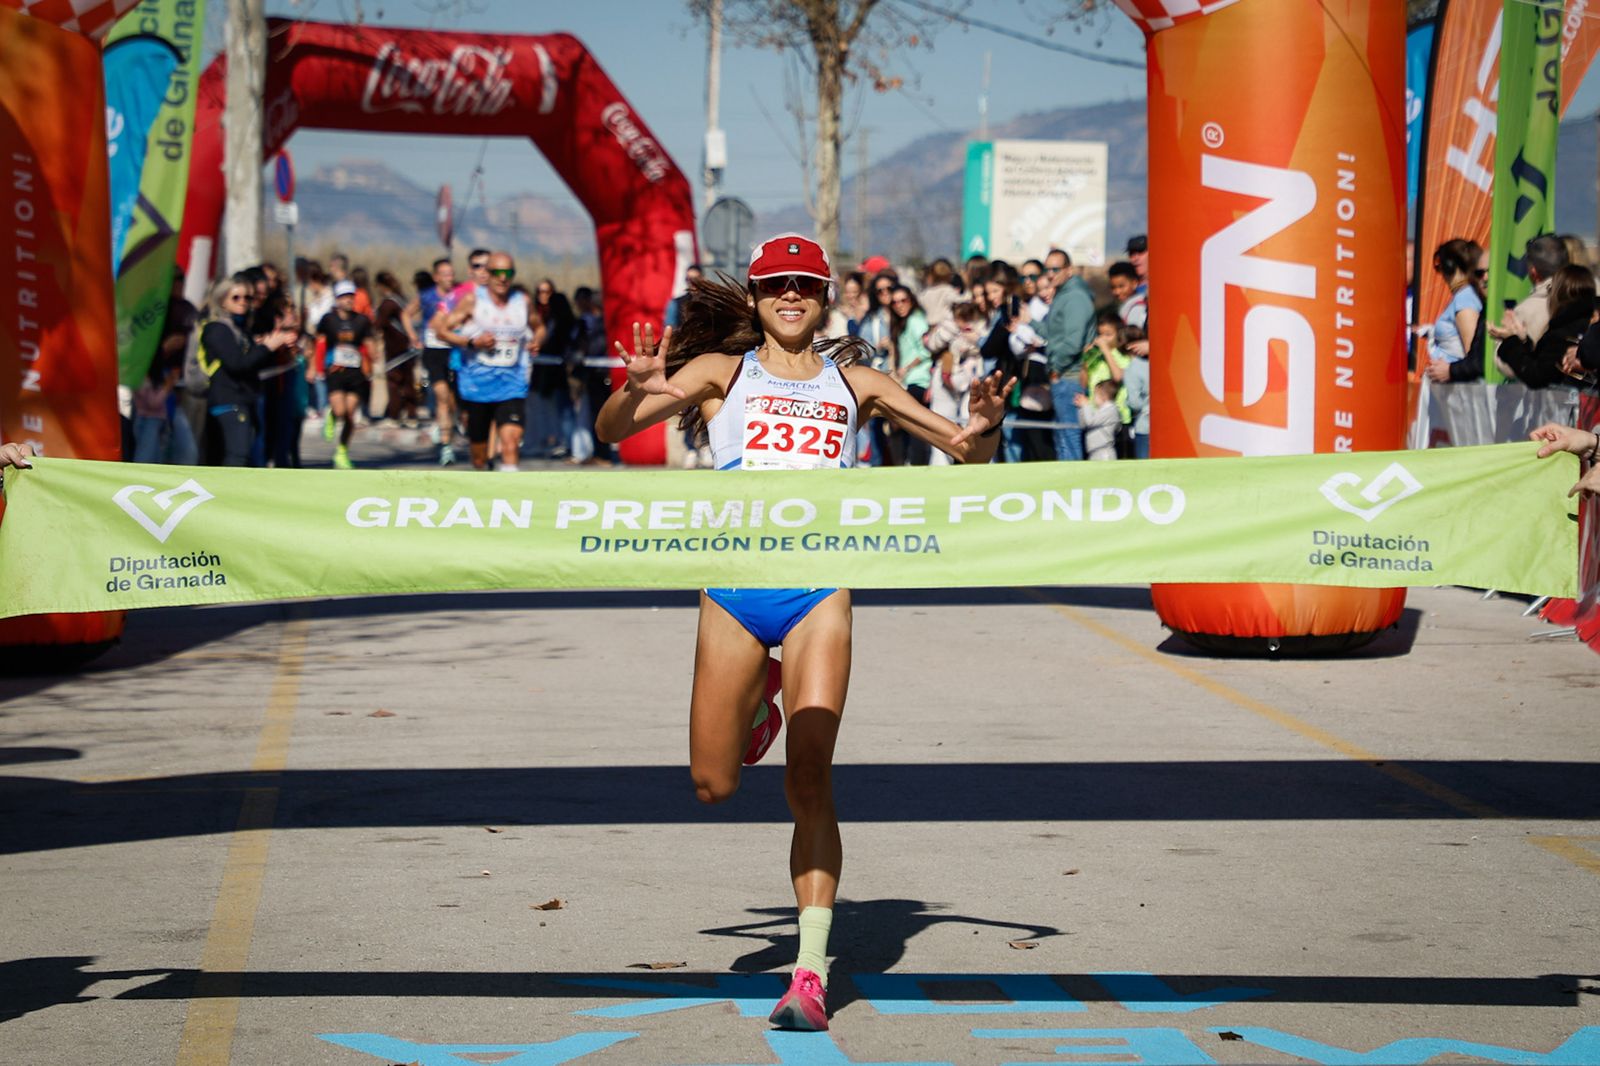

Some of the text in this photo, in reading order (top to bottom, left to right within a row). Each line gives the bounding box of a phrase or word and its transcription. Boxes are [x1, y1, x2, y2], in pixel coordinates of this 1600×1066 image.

[157, 118, 184, 161] de
[14, 153, 42, 392] NUTRITION!
[1334, 153, 1356, 452] RE NUTRITION!
[769, 403, 826, 419] FONDO
[745, 420, 844, 459] 2325
[345, 484, 1186, 531] GRAN PREMIO DE FONDO
[580, 533, 941, 554] DIPUTACIÓN DE GRANADA
[1313, 530, 1430, 552] Diputación
[109, 551, 221, 573] Diputación
[1309, 550, 1433, 572] de Granada
[106, 570, 227, 593] de Granada
